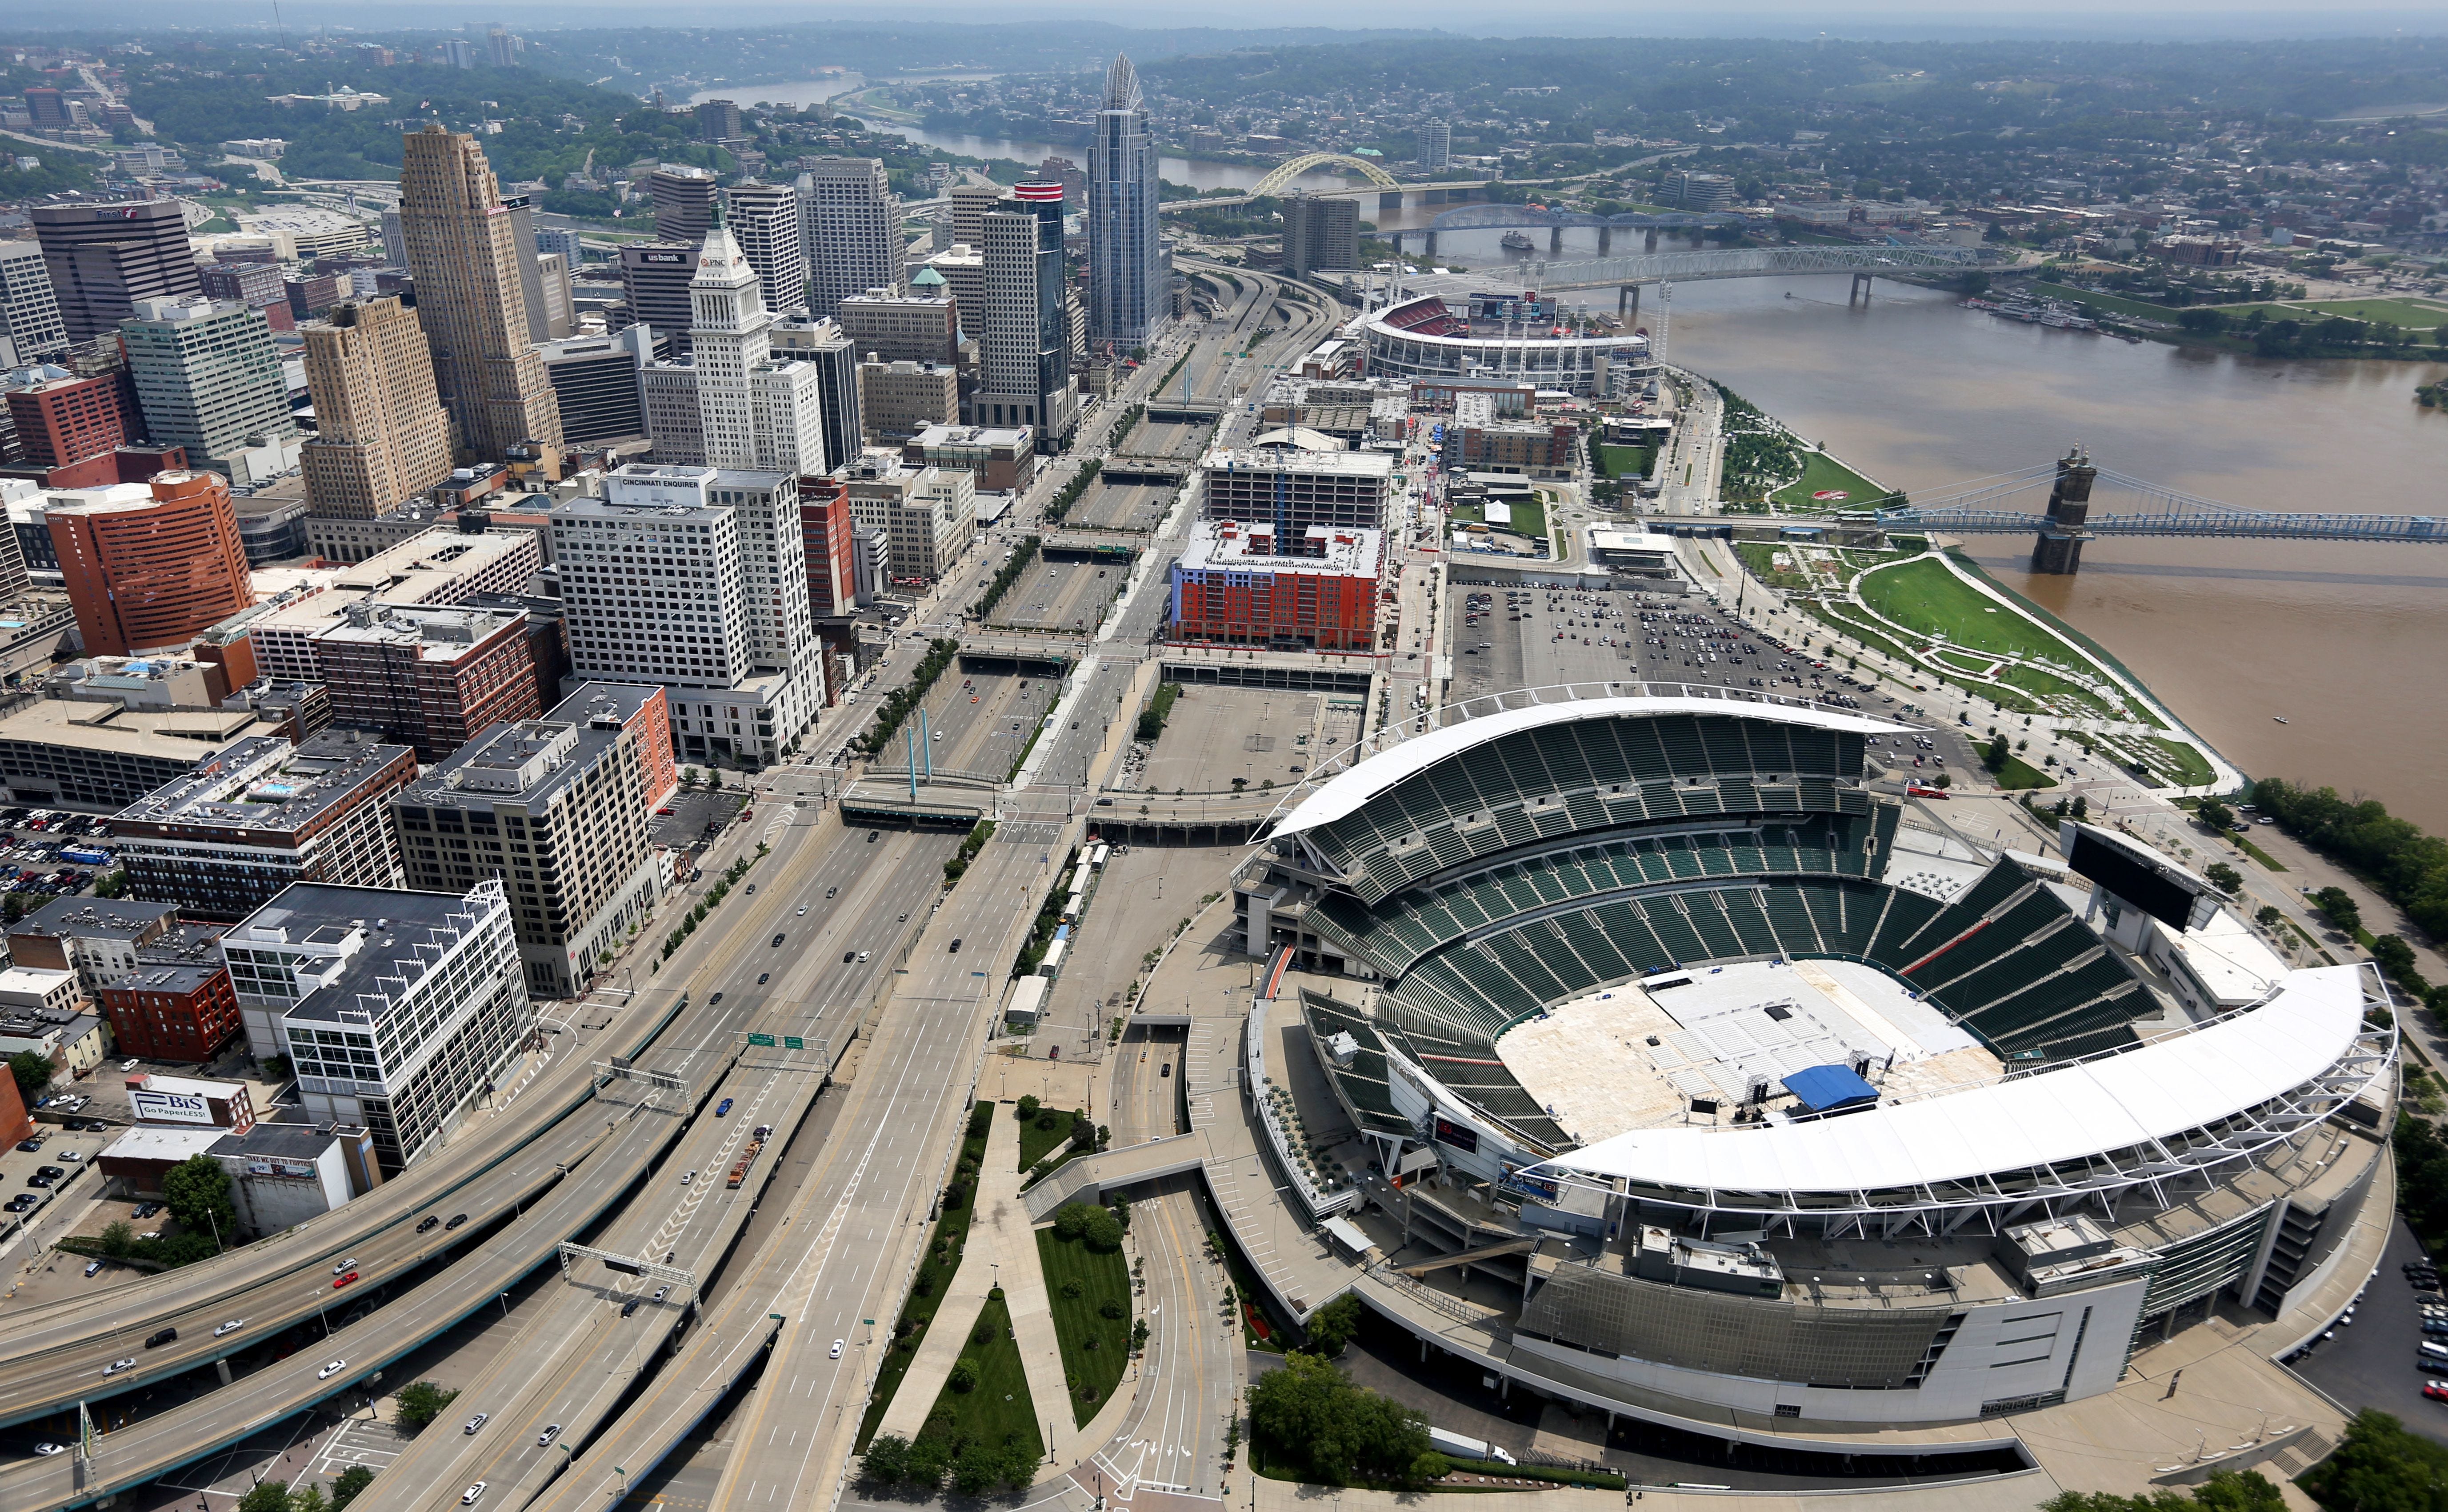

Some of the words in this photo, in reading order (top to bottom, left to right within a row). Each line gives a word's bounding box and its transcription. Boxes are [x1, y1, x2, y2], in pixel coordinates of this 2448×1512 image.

[96, 209, 122, 218] First
[1417, 1084, 1437, 1106] STADIUM
[159, 1108, 206, 1118] PaperLESS!
